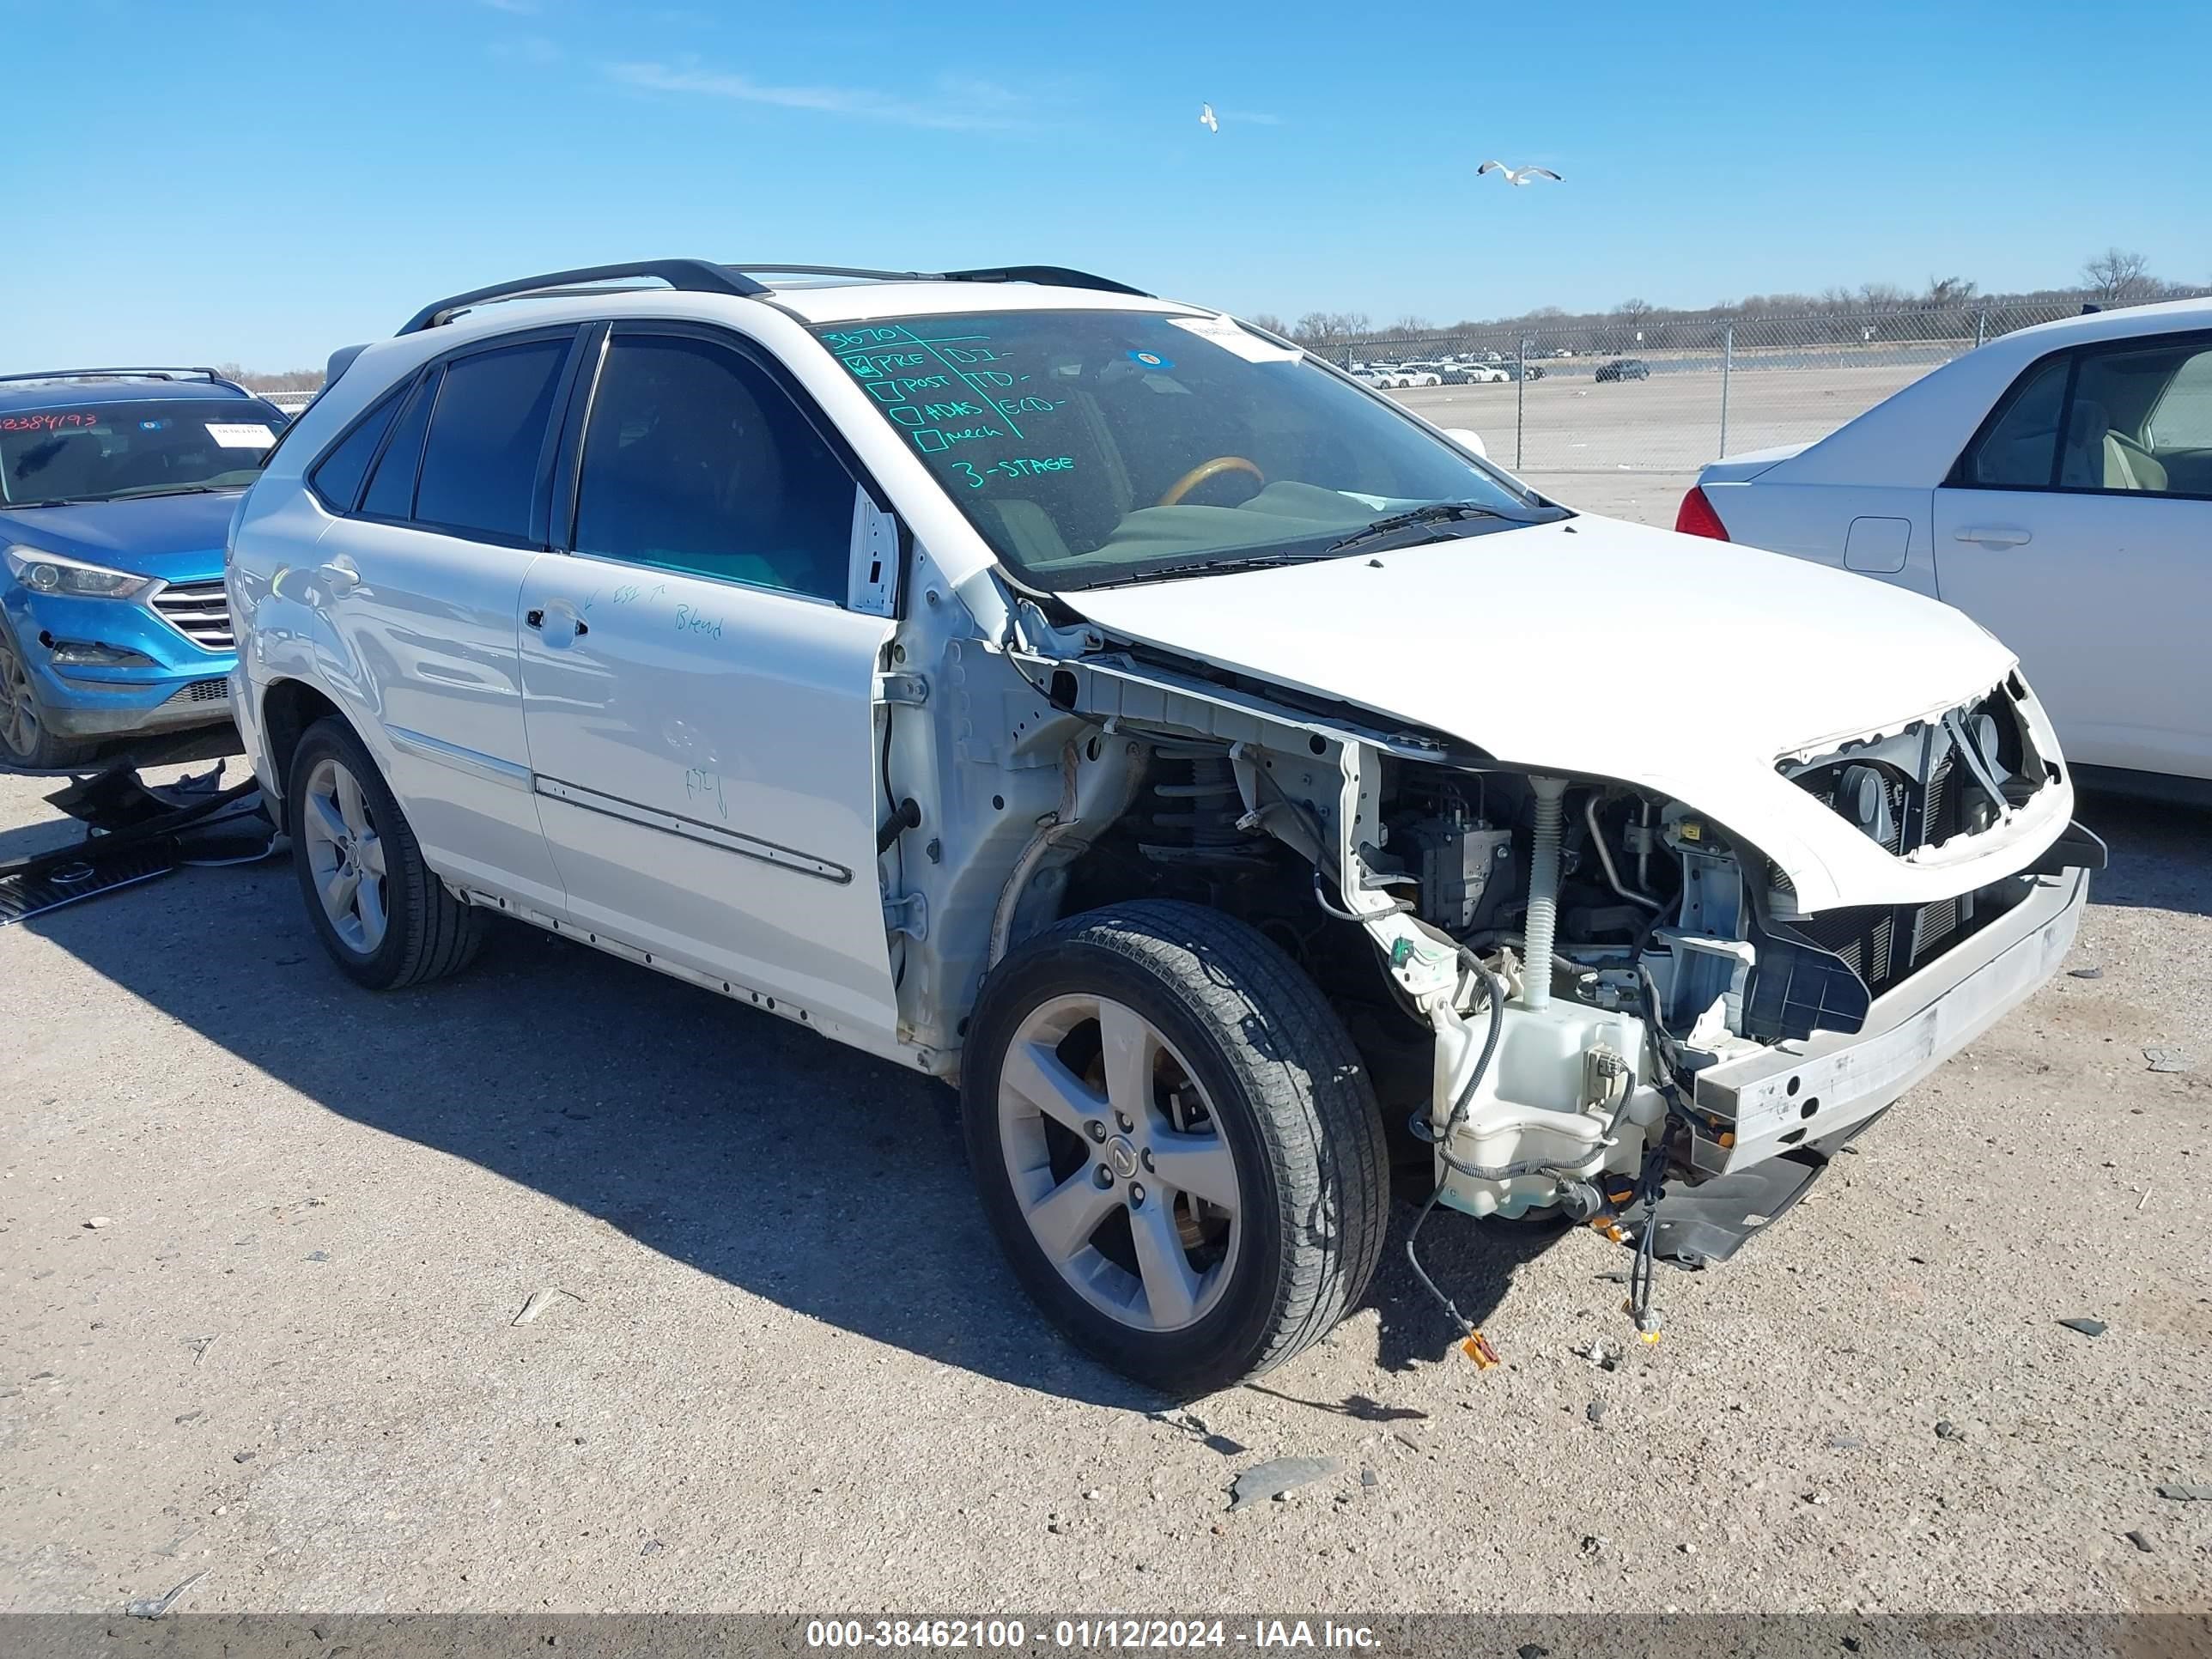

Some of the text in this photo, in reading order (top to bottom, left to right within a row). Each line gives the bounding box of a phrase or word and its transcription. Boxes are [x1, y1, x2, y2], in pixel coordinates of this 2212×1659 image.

[870, 353, 925, 373] PRE
[897, 375, 952, 392] POST
[924, 401, 983, 421] ADAS
[0, 414, 97, 430] 8384193
[675, 604, 724, 641] Blend
